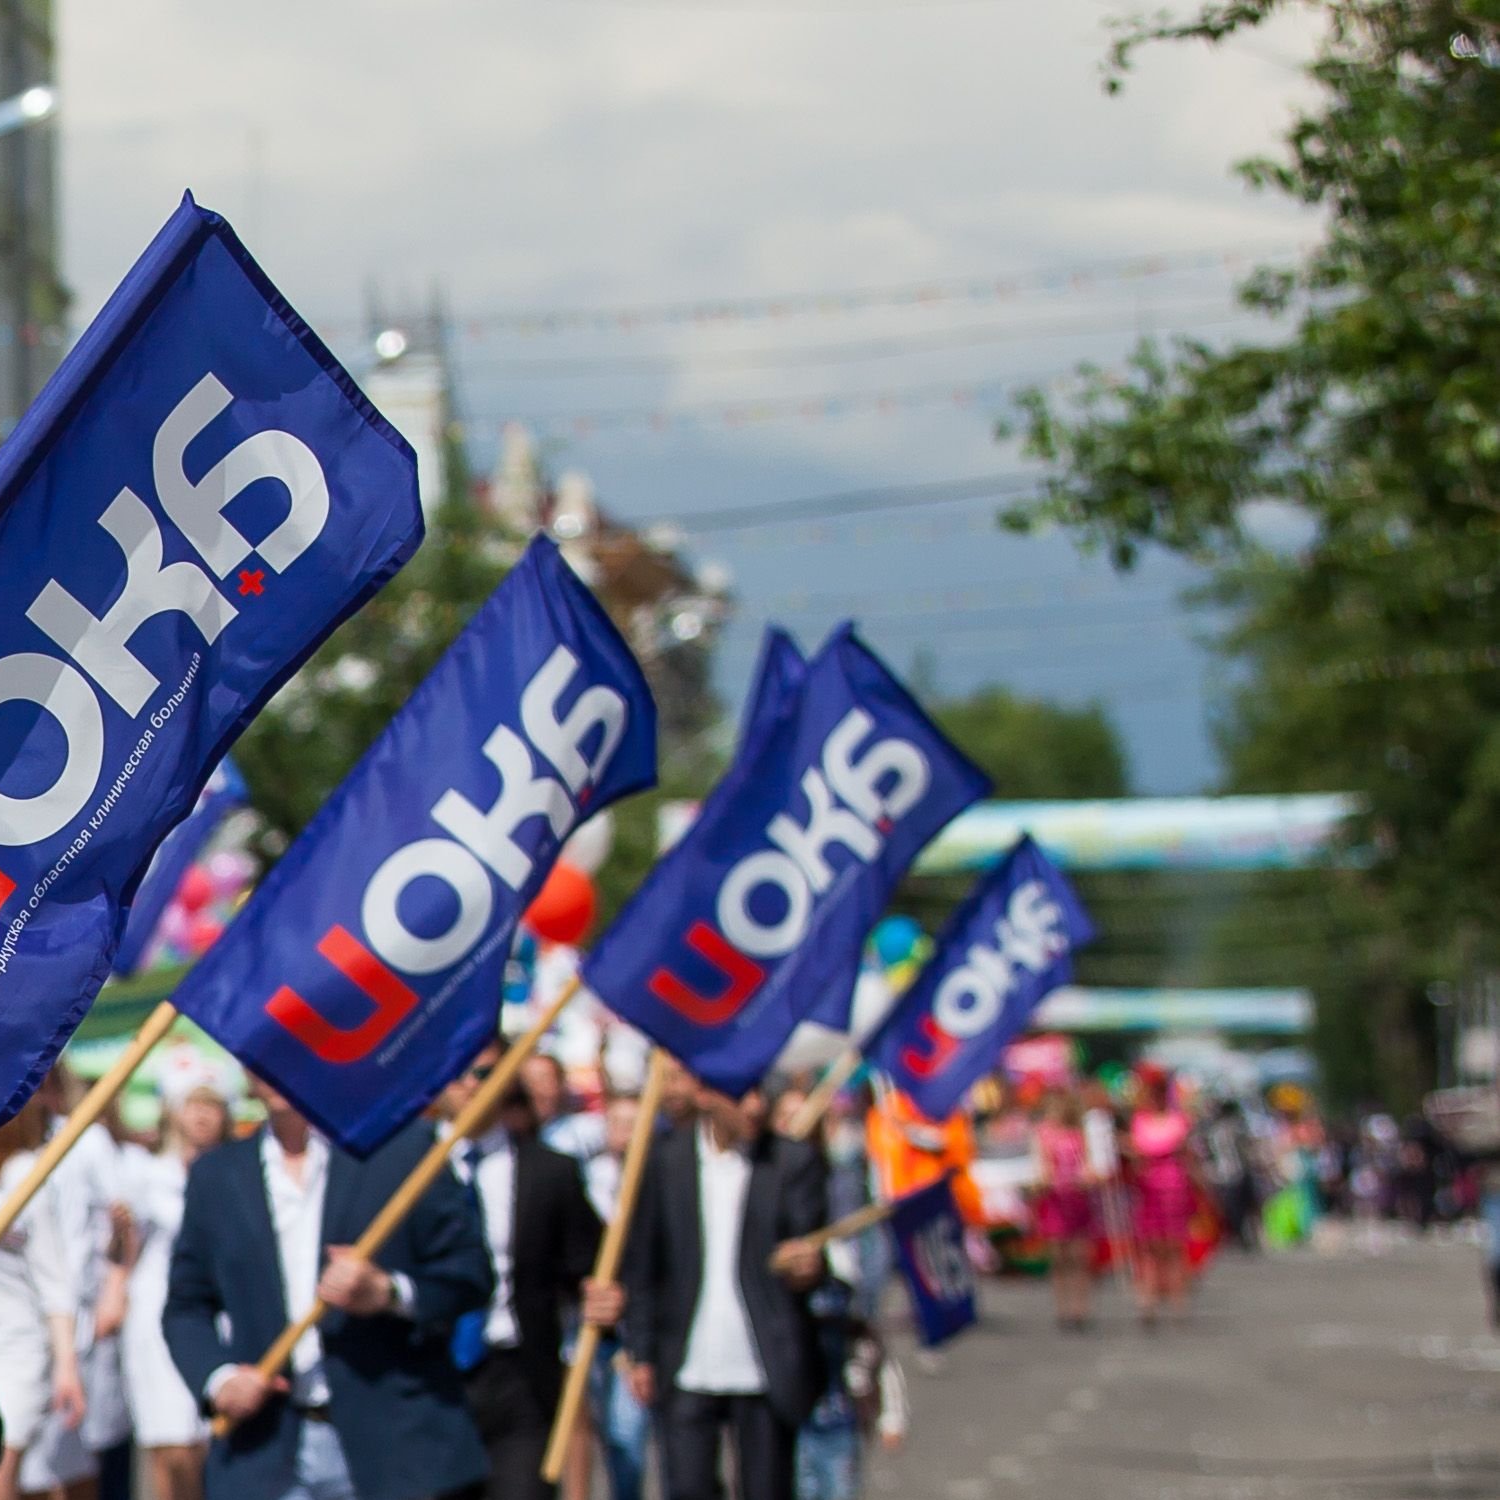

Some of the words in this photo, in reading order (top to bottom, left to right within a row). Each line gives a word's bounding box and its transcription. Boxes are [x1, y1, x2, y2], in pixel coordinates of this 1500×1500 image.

[29, 829, 92, 909] областная
[89, 729, 155, 829] клиническая
[150, 652, 201, 729] больница
